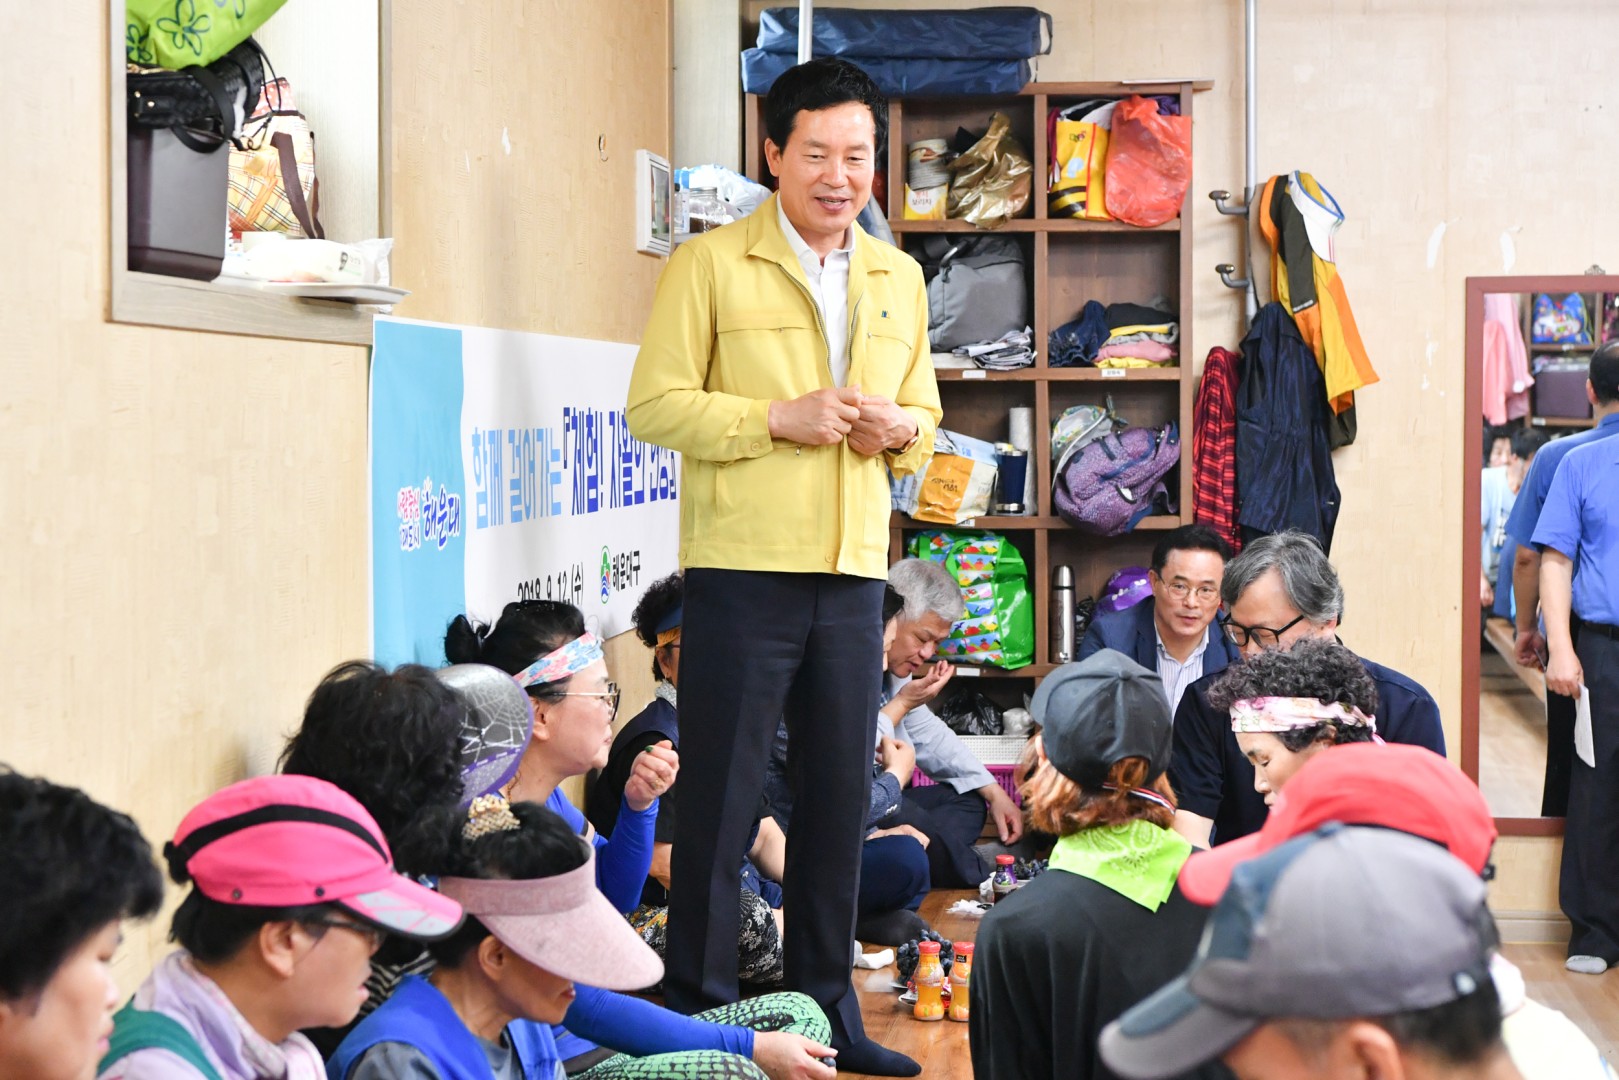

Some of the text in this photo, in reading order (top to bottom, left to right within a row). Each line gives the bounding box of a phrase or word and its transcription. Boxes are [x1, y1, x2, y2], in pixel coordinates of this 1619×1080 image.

[472, 427, 503, 529] 함께
[508, 428, 561, 523] 걸어가는
[423, 486, 460, 547] 해운대
[612, 550, 640, 589] 해운대구
